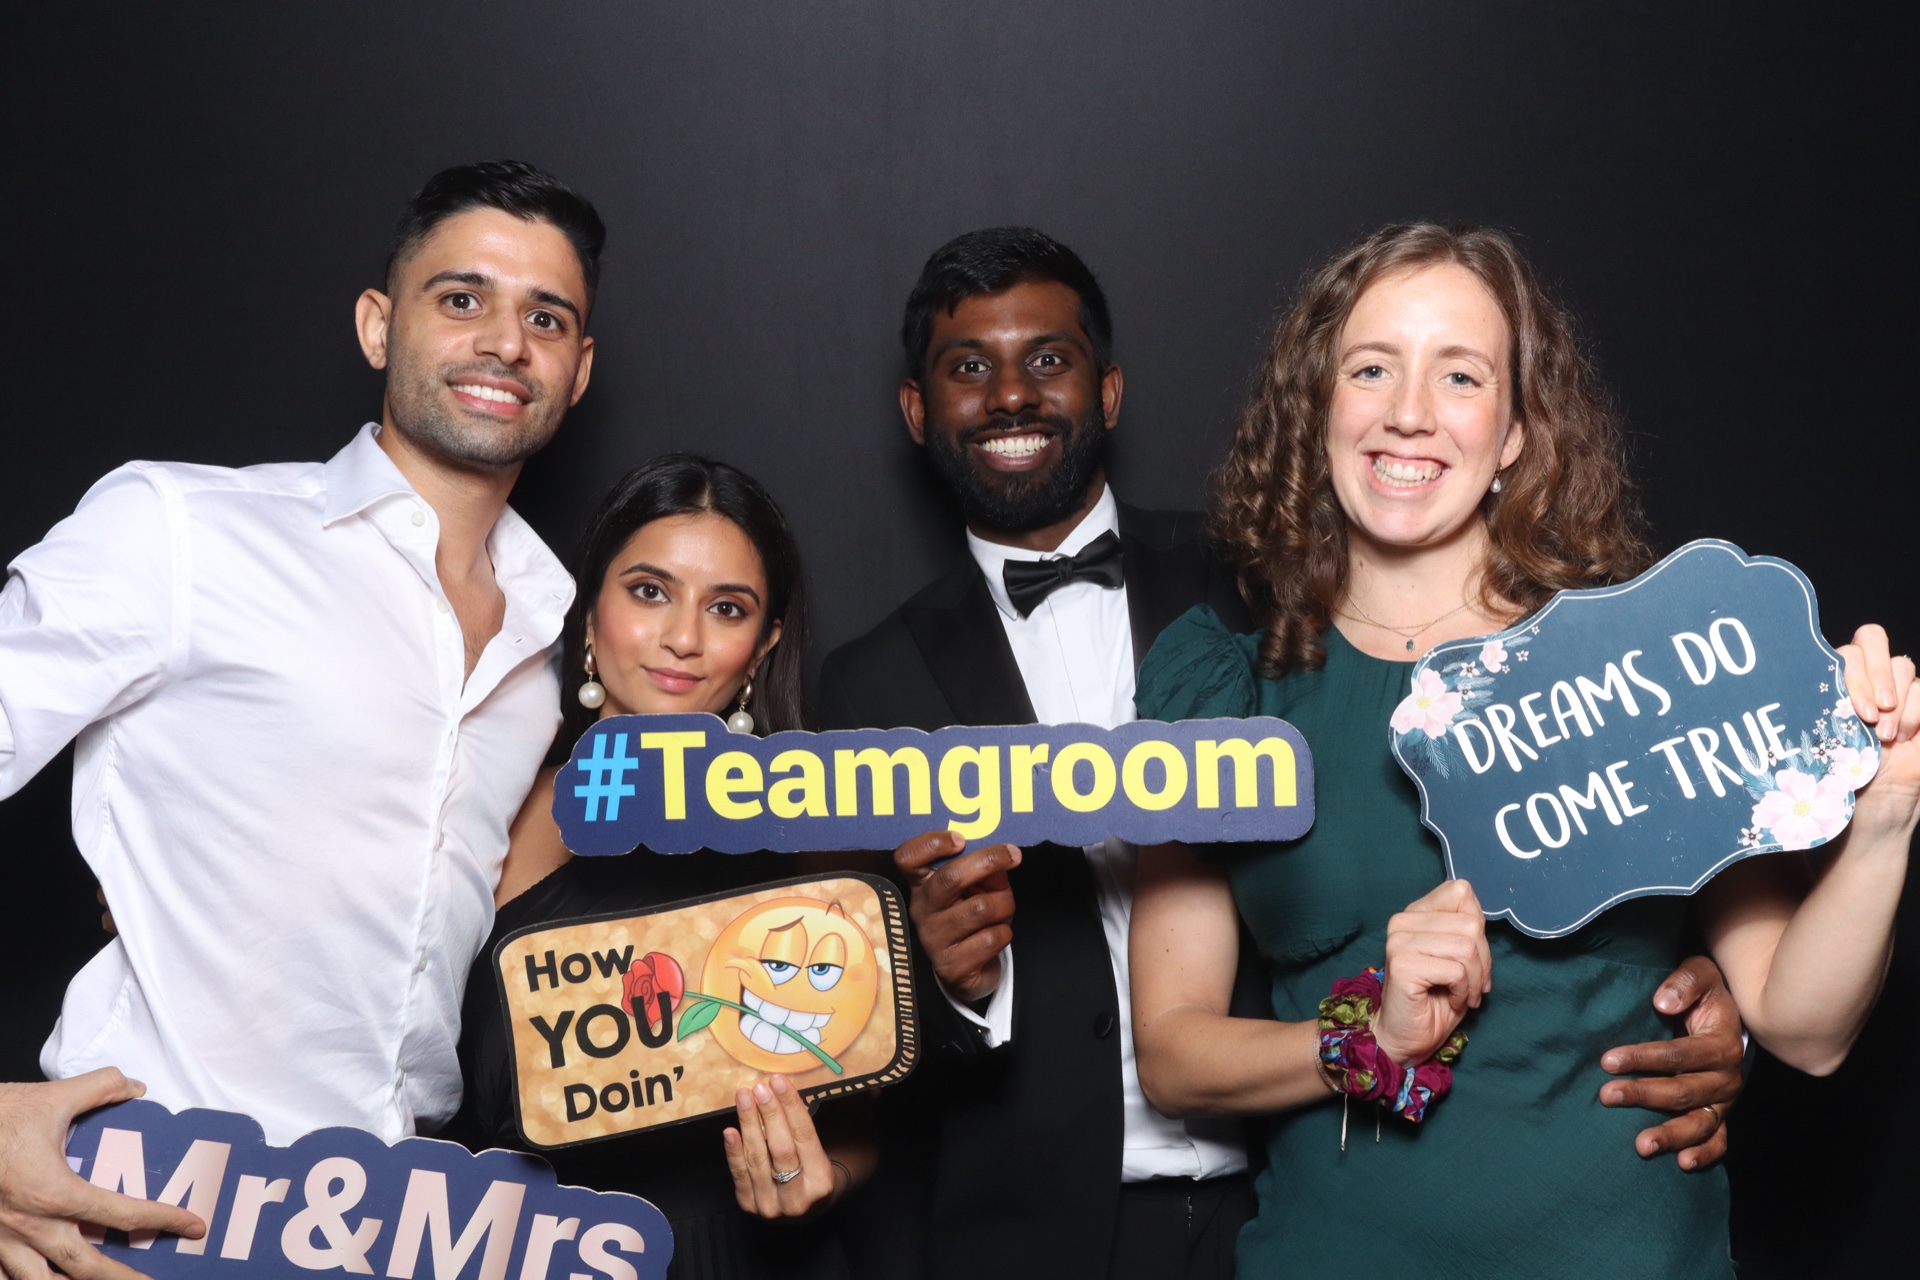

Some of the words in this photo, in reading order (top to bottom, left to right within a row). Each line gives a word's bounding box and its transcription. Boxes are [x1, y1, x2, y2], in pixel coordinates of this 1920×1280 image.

[1453, 649, 1672, 775] DREAMS
[1672, 617, 1757, 685] DO
[574, 731, 1298, 840] #Teamgroom
[1494, 760, 1649, 859] COME
[1649, 703, 1801, 799] TRUE
[524, 945, 634, 992] How
[529, 991, 674, 1069] YOU
[66, 1124, 646, 1280] Mr&Mrs
